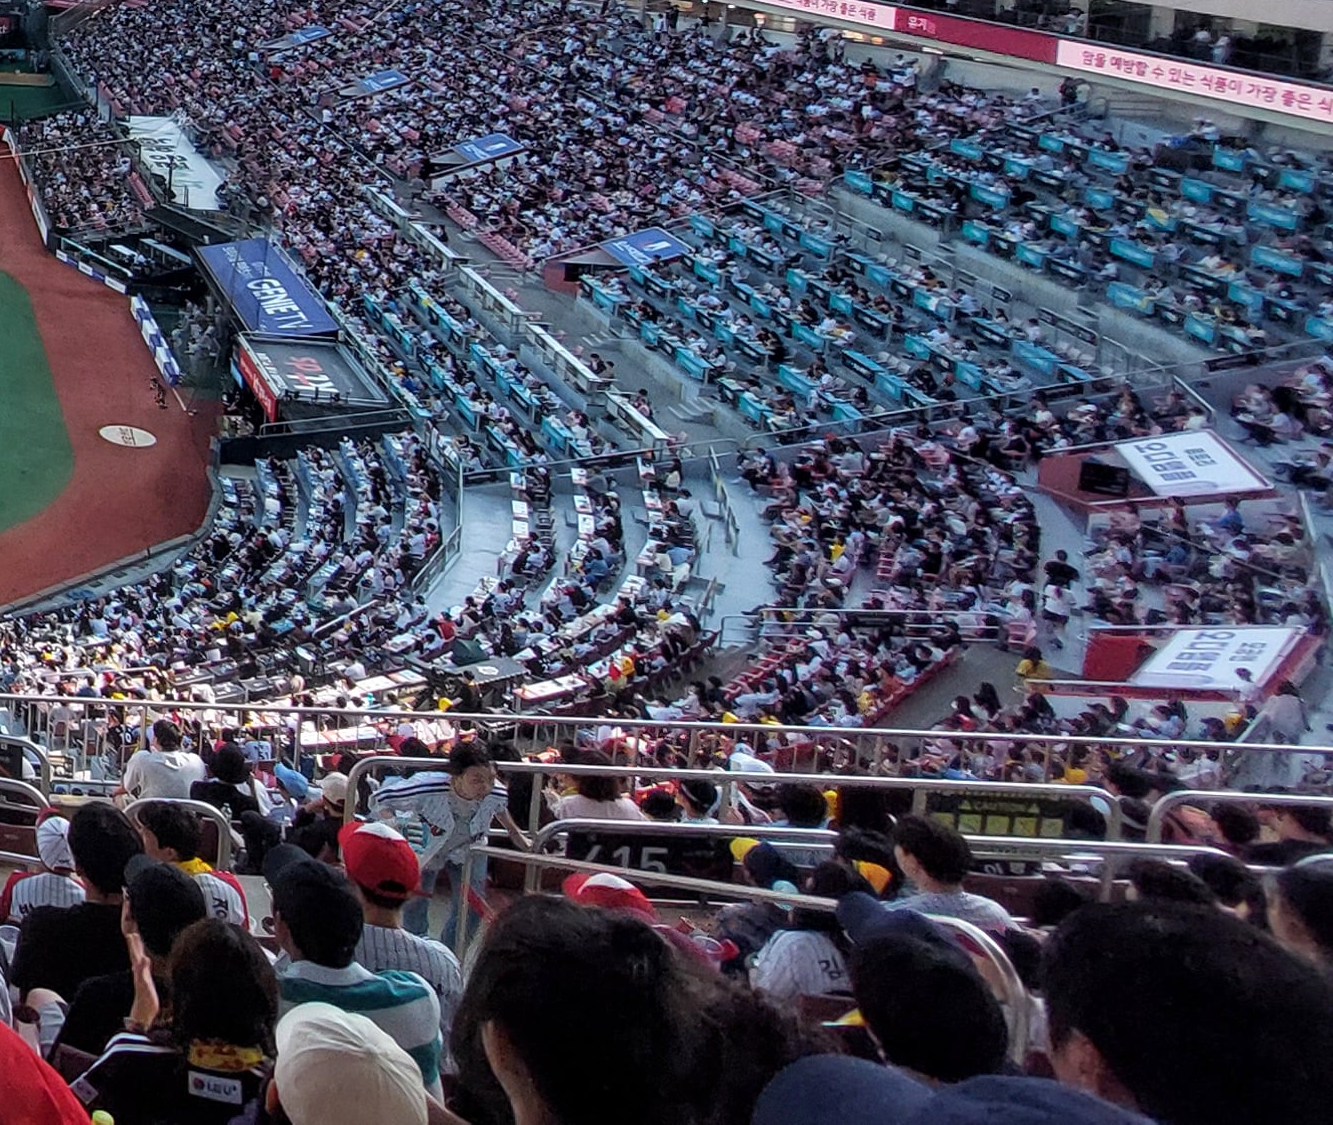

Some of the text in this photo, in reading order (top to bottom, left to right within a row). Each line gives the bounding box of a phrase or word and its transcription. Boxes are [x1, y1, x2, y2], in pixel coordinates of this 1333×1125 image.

[821, 0, 838, 13] 가장
[1082, 50, 1106, 68] 암을
[1109, 56, 1149, 77] 예방할
[1151, 66, 1164, 77] 수
[1168, 68, 1195, 87] 있는
[1200, 75, 1242, 95] 식품이
[1247, 83, 1277, 101] 가장
[1281, 91, 1313, 111] 좋은
[247, 278, 298, 316] GENIE
[273, 310, 314, 330] TV
